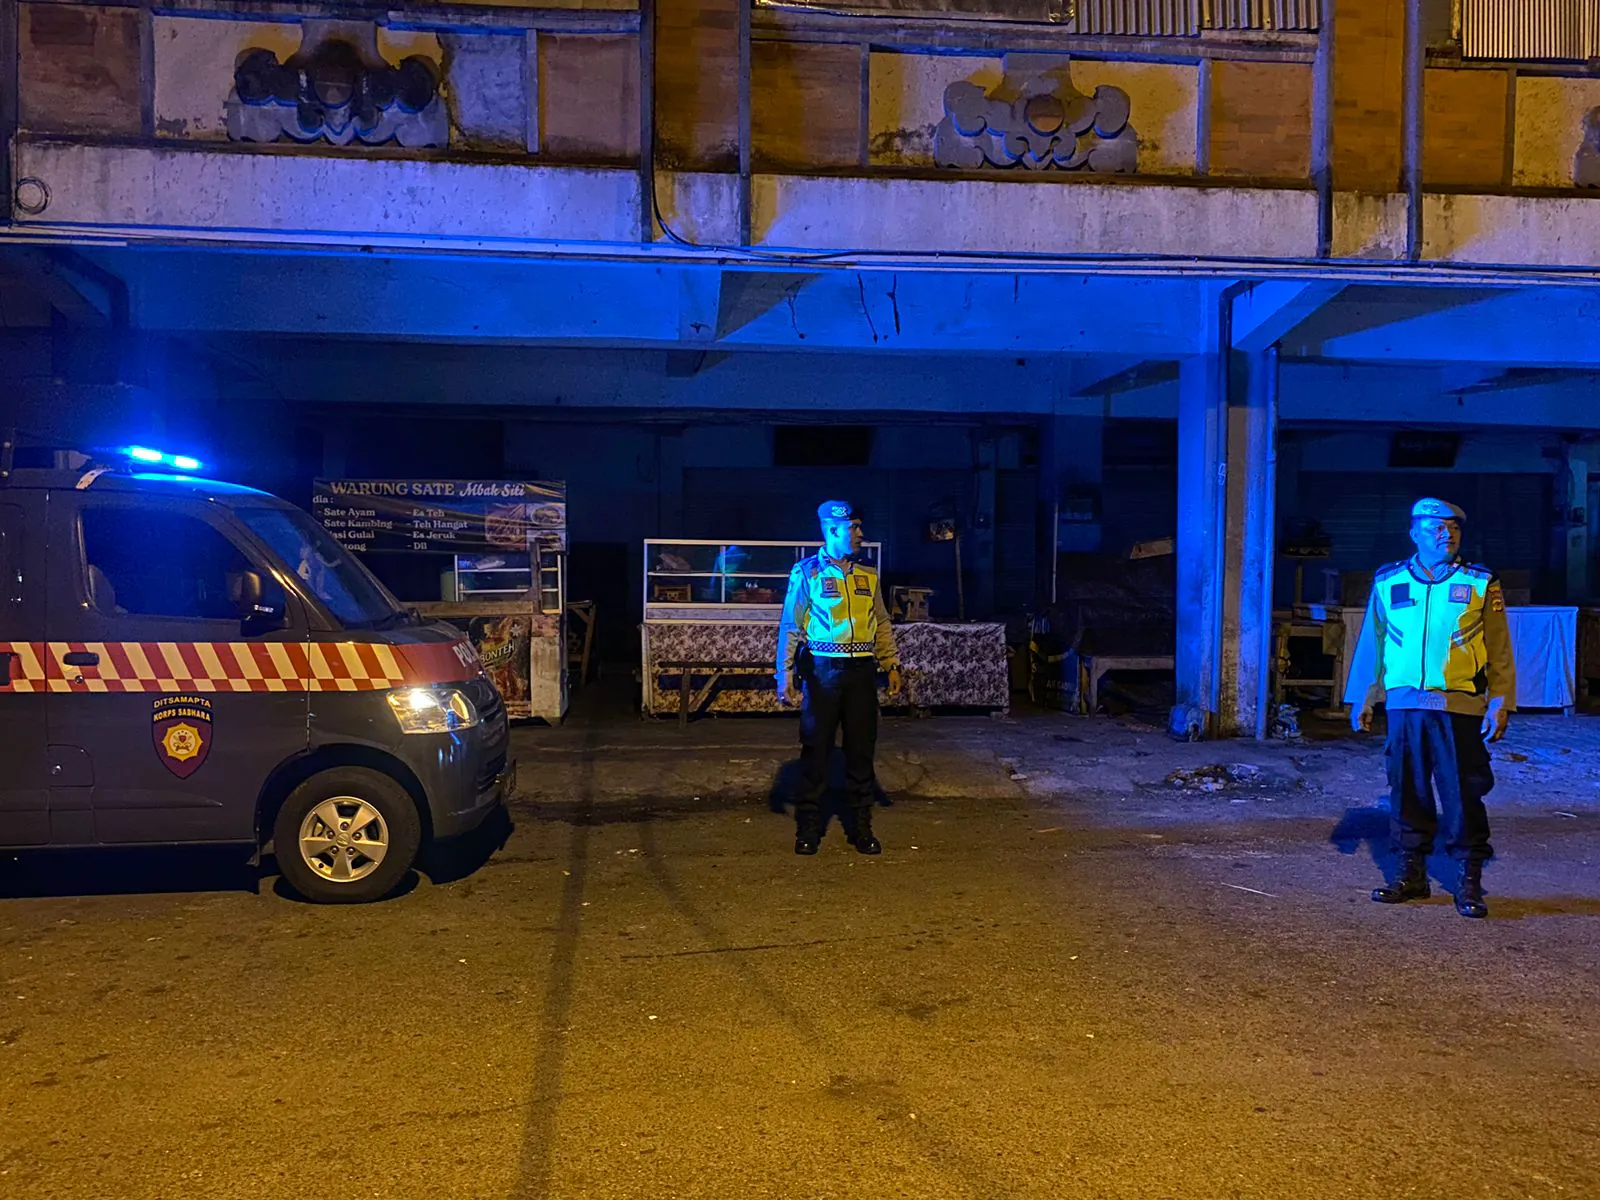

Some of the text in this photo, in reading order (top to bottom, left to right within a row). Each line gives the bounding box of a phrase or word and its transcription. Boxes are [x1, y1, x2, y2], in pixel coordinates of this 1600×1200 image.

[330, 482, 526, 497] WARUNG SATE Mbak Siti
[324, 508, 346, 516] Sate
[348, 508, 376, 518] Ayam
[426, 509, 445, 517] Teh
[324, 519, 393, 529] Sate Kambing
[412, 520, 432, 528] Teh
[433, 520, 468, 530] Hangat
[329, 530, 375, 539] asi Gulai
[412, 531, 425, 539] Es
[426, 531, 456, 539] Jeruk
[153, 696, 211, 709] DITSAMAPTA
[153, 708, 211, 722] KORPS SABHARA
